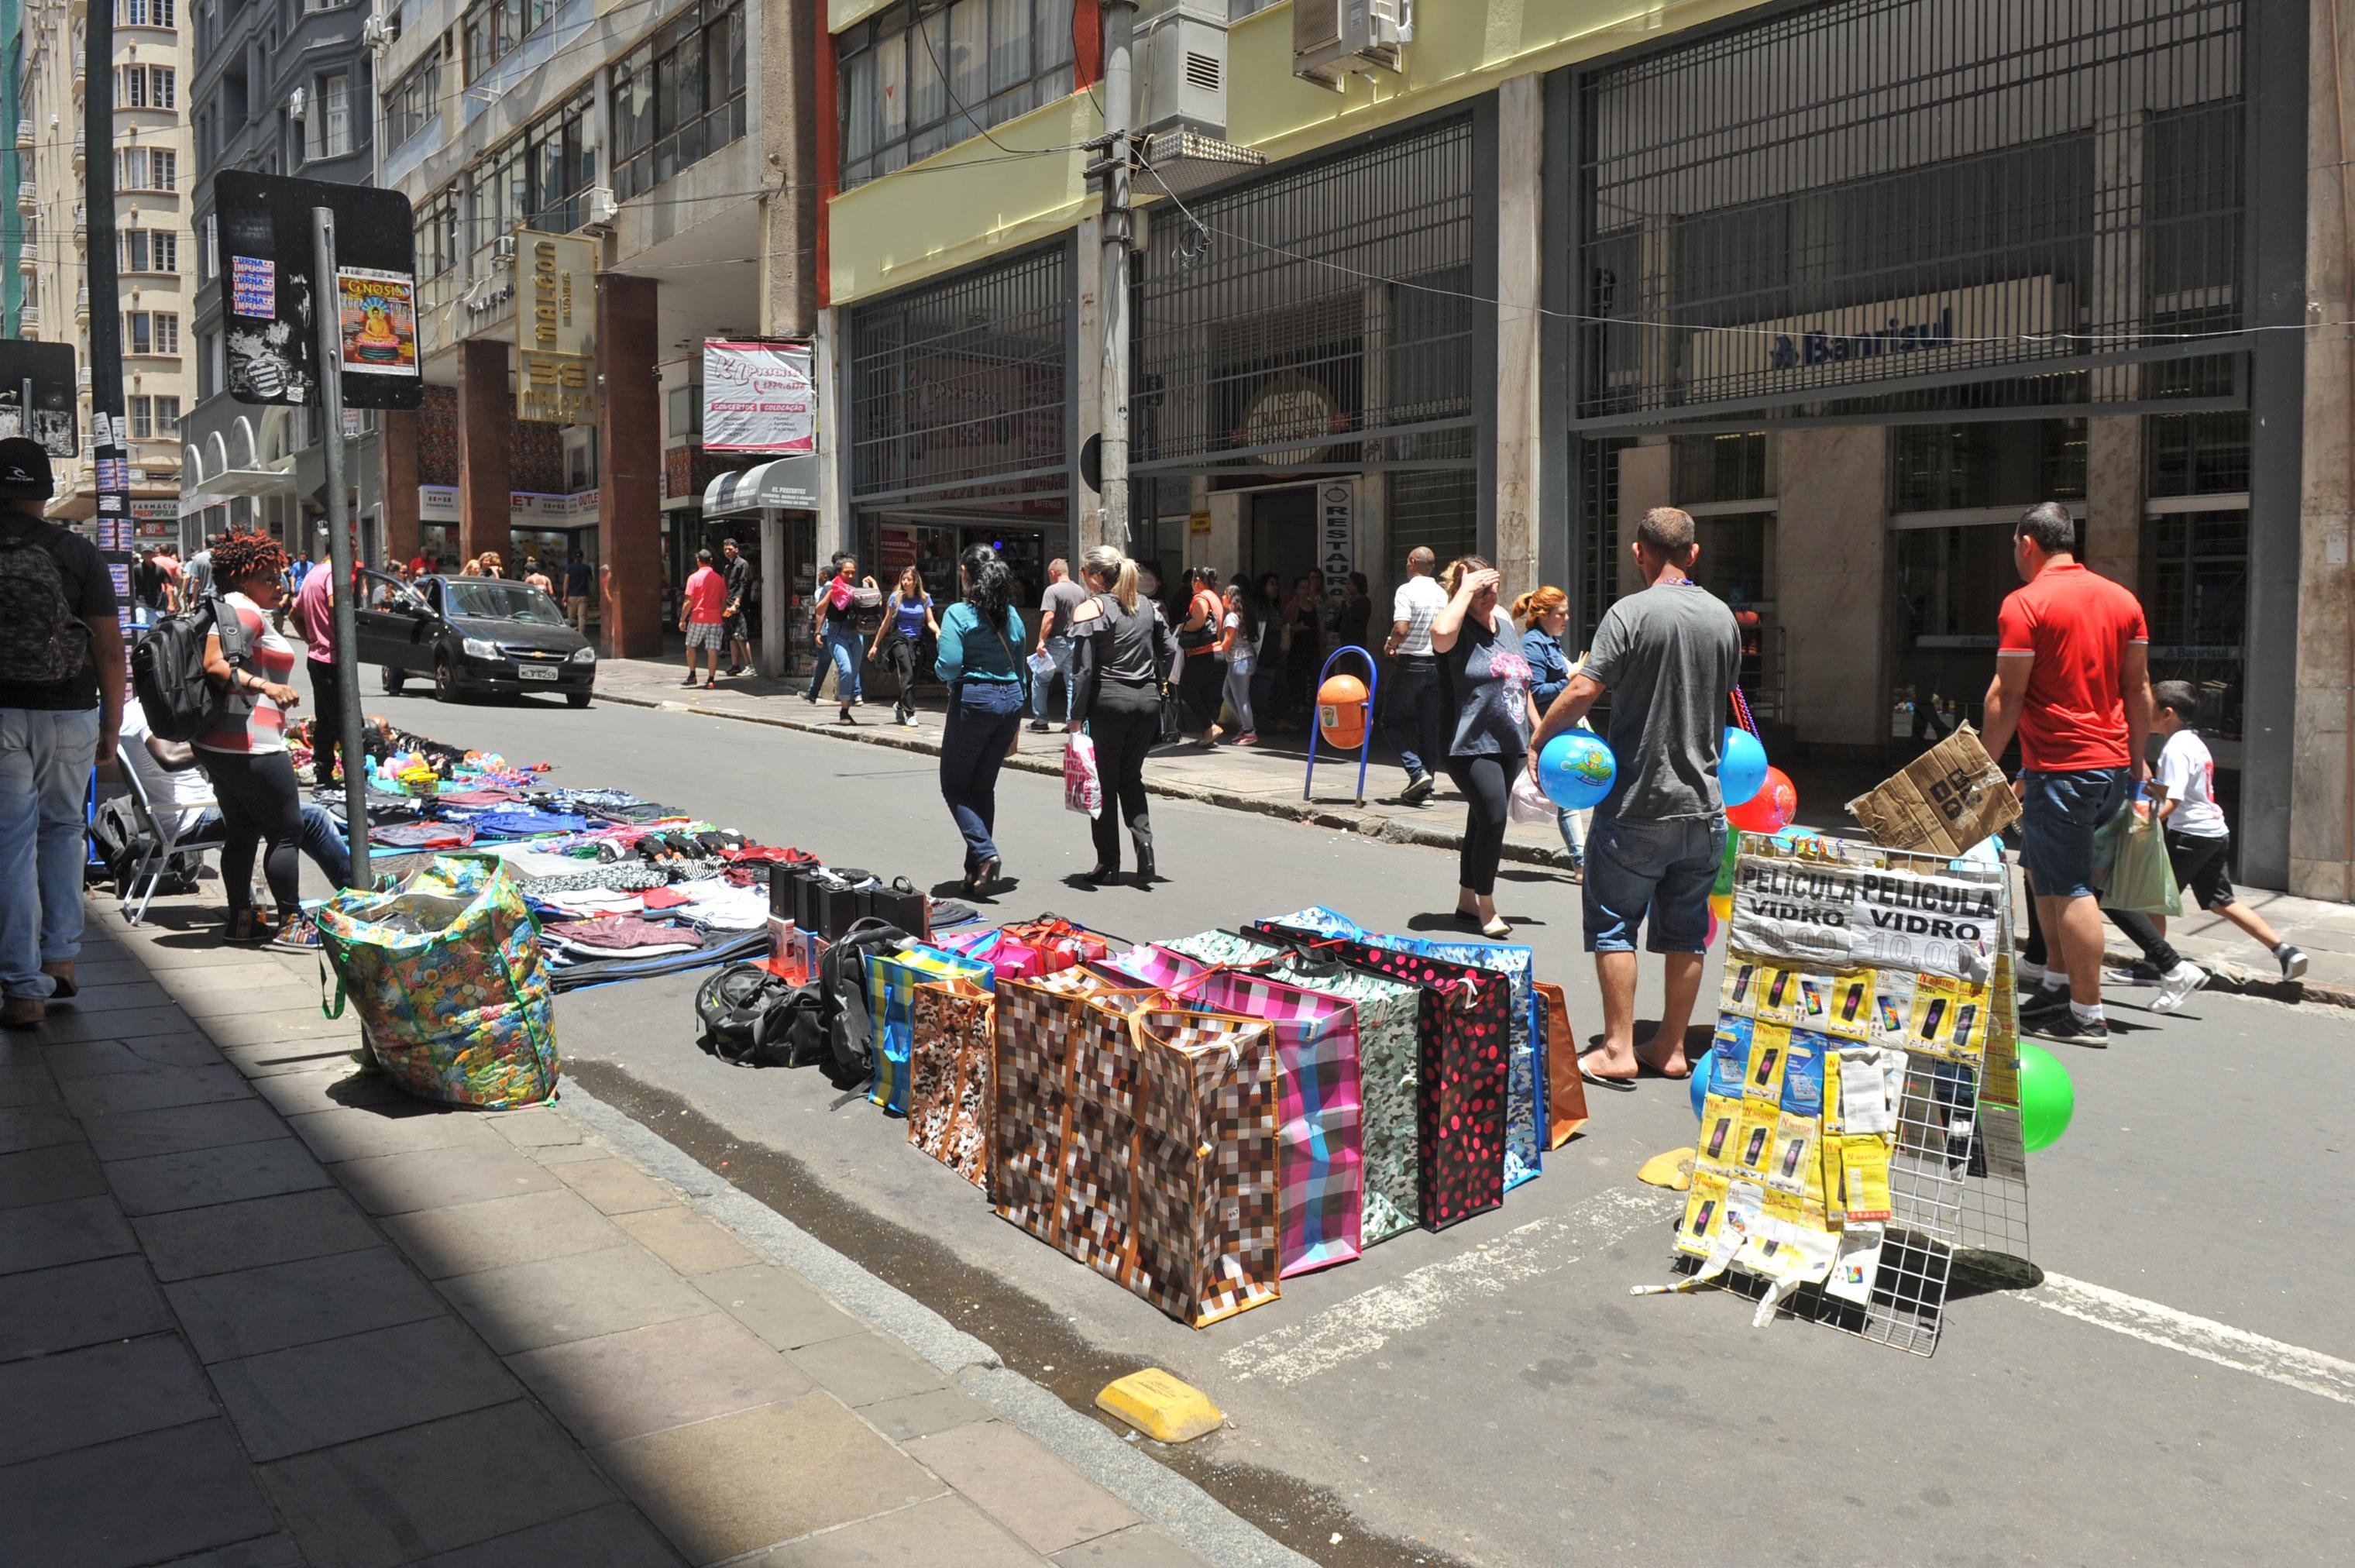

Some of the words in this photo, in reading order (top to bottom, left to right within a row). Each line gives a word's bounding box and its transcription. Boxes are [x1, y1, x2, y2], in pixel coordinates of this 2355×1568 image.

[238, 257, 263, 266] URNA
[238, 277, 263, 285] URNA
[348, 280, 403, 296] GNOSIS
[239, 295, 264, 304] URNA
[1803, 307, 1952, 365] Banrisul
[578, 493, 598, 506] OUTLE
[1325, 506, 1349, 597] RESTAURA
[2178, 647, 2230, 658] Banrisul
[1862, 873, 1996, 920] PELÍCULA
[1748, 897, 1845, 927] VIDRO
[1869, 909, 1982, 941] VIDRO
[1867, 931, 1972, 974] 10,00
